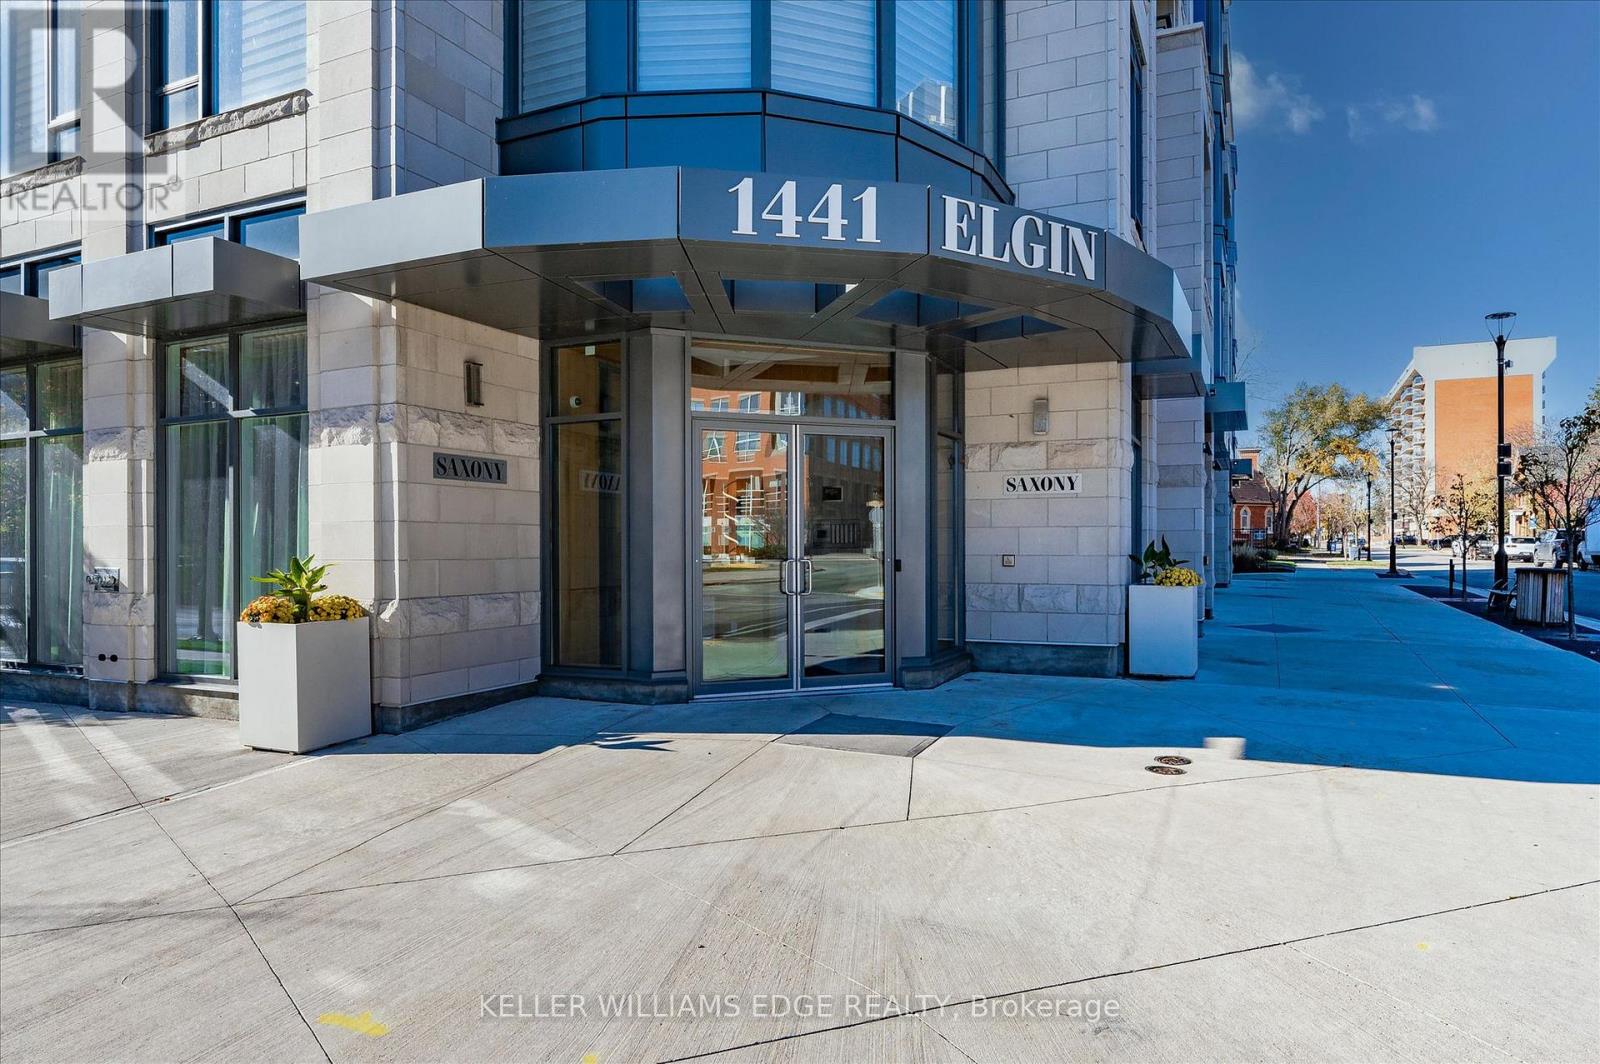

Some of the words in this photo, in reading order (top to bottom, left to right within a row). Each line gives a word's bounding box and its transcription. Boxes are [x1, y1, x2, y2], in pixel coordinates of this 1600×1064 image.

[728, 177, 880, 243] 1441
[942, 194, 1098, 281] ELGIN
[436, 456, 504, 480] SAXONY
[1006, 475, 1079, 492] SAXONY
